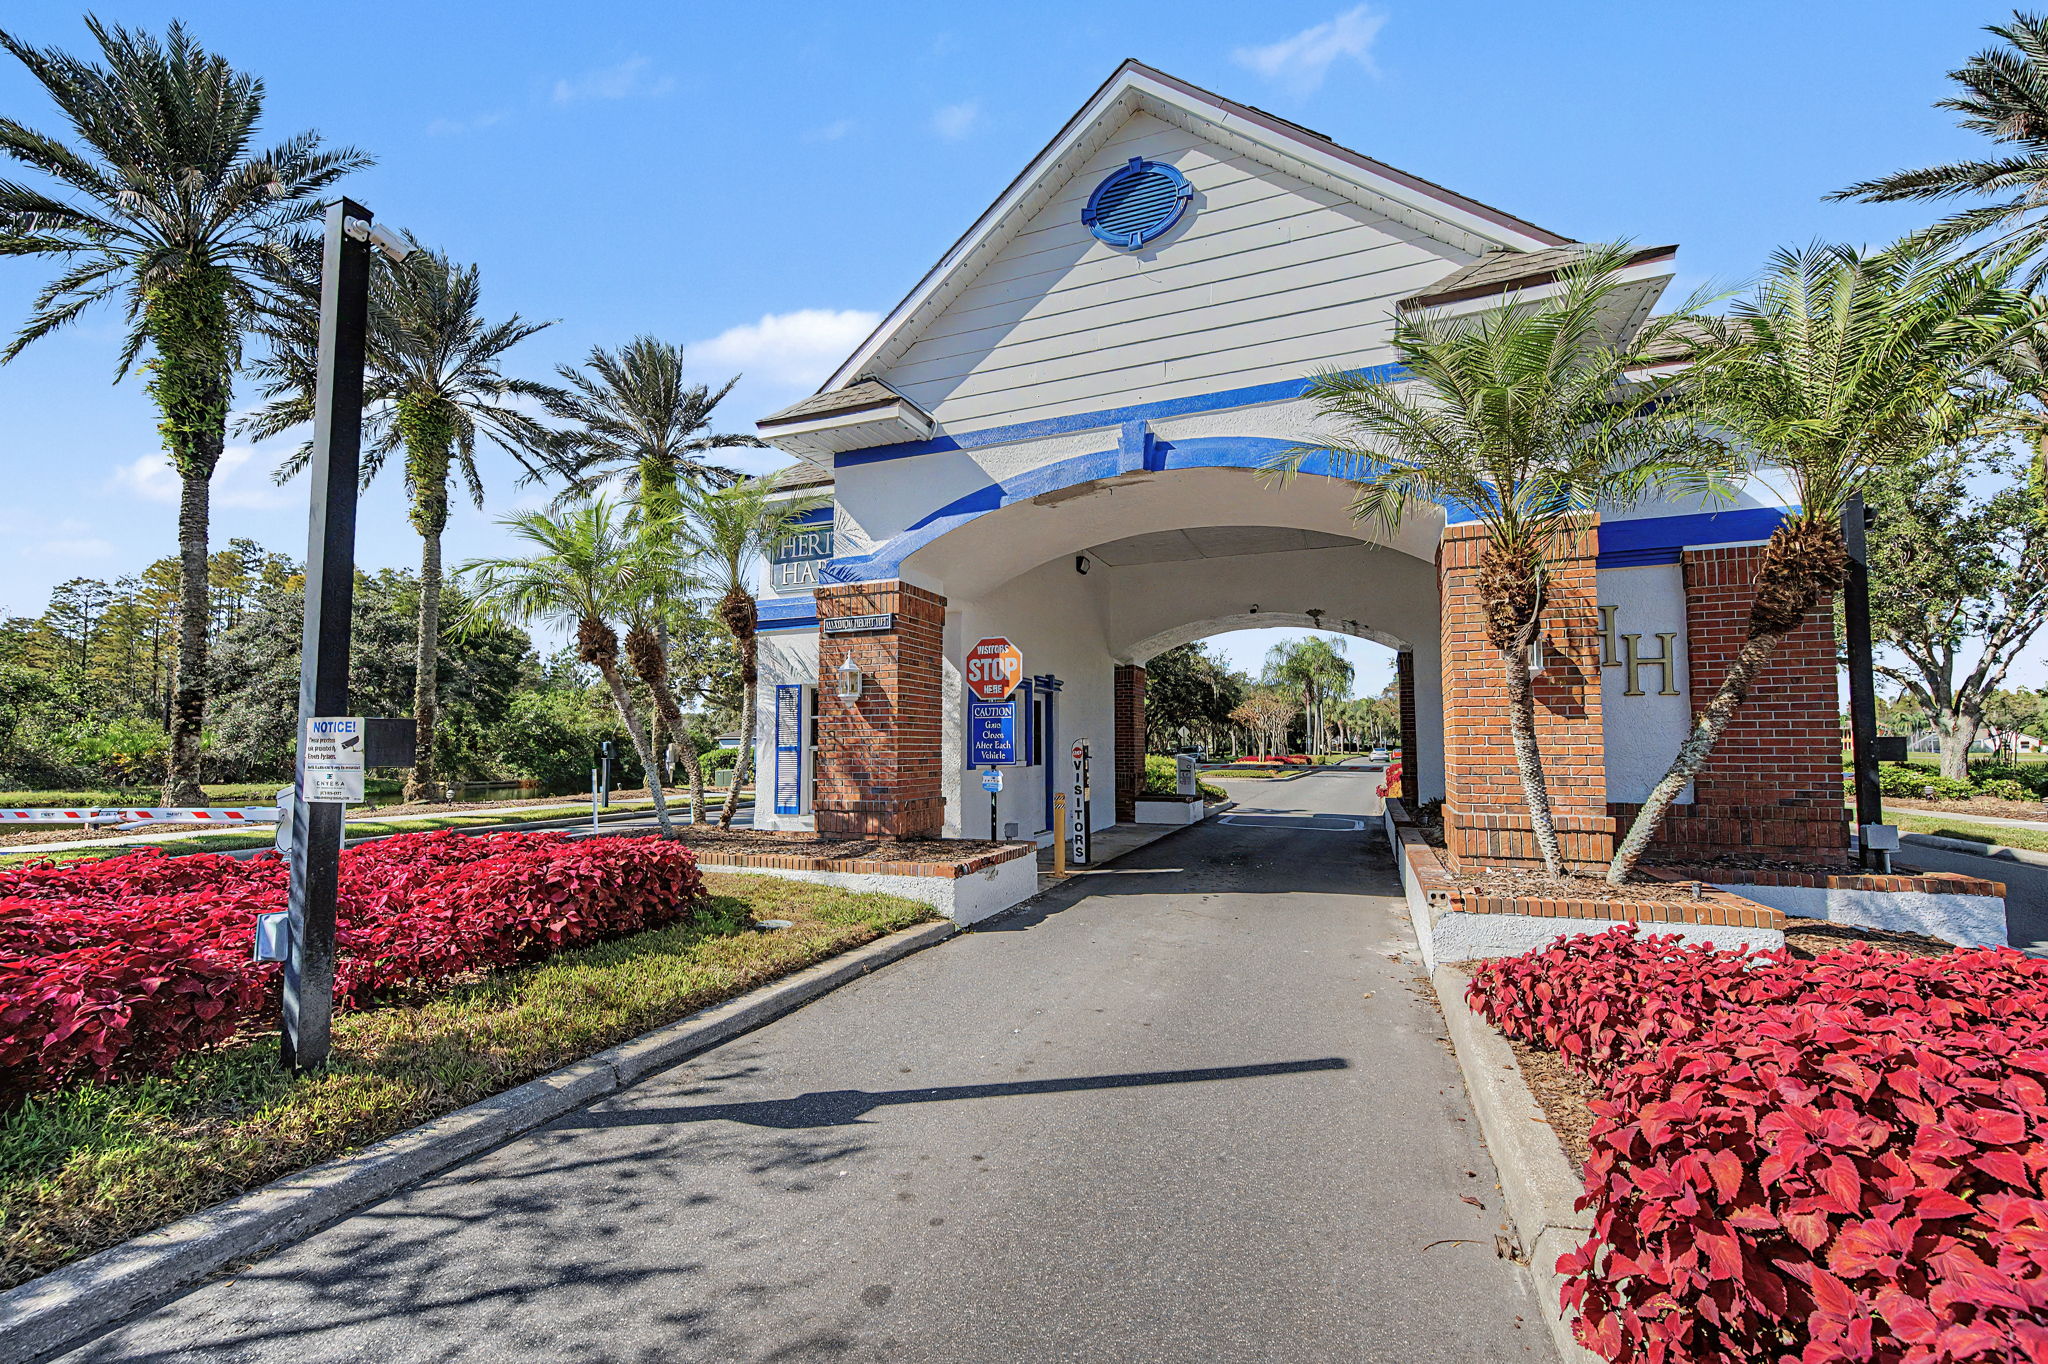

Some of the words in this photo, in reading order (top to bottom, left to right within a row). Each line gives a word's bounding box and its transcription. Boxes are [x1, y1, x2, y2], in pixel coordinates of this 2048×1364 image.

[780, 531, 834, 559] HERI
[977, 644, 1009, 655] VISITORS
[968, 658, 1018, 682] STOP
[983, 684, 1002, 694] HERE
[974, 707, 1012, 717] CAUTION
[313, 721, 356, 733] NOTICE!
[985, 721, 1001, 729] Gate
[982, 731, 1005, 739] Closes
[975, 741, 993, 749] After
[994, 740, 1011, 749] Each
[981, 751, 1006, 760] Vehicle
[1073, 760, 1084, 858] VISITORS
